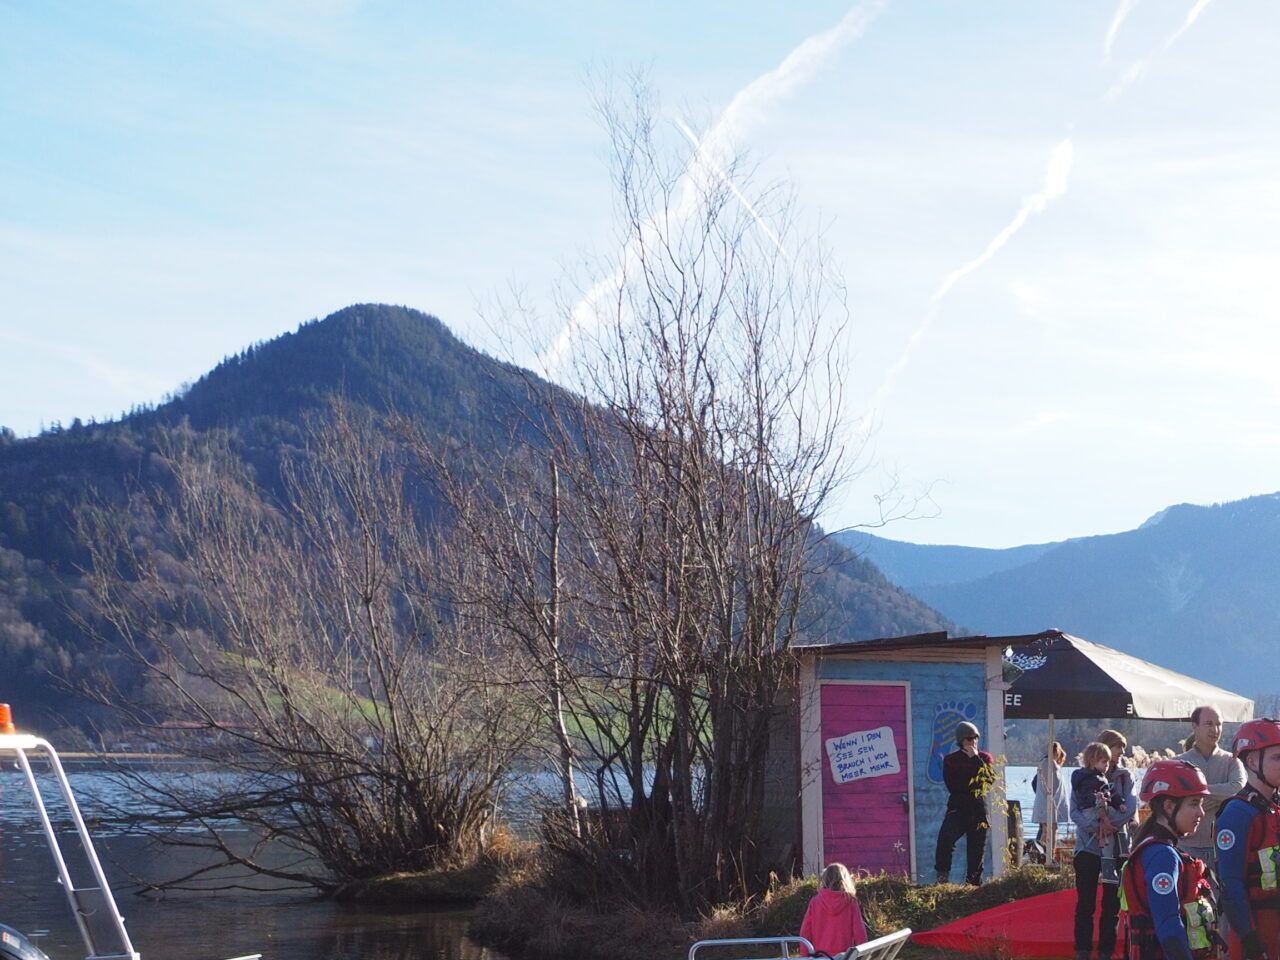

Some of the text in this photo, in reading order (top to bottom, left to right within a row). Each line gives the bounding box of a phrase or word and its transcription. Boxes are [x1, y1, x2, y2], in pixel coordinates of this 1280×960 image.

[833, 738, 858, 751] WENN
[867, 732, 882, 741] DEN
[836, 751, 853, 762] SEE
[837, 758, 865, 773] BRAUCH
[841, 761, 894, 781] MEER MEHR
